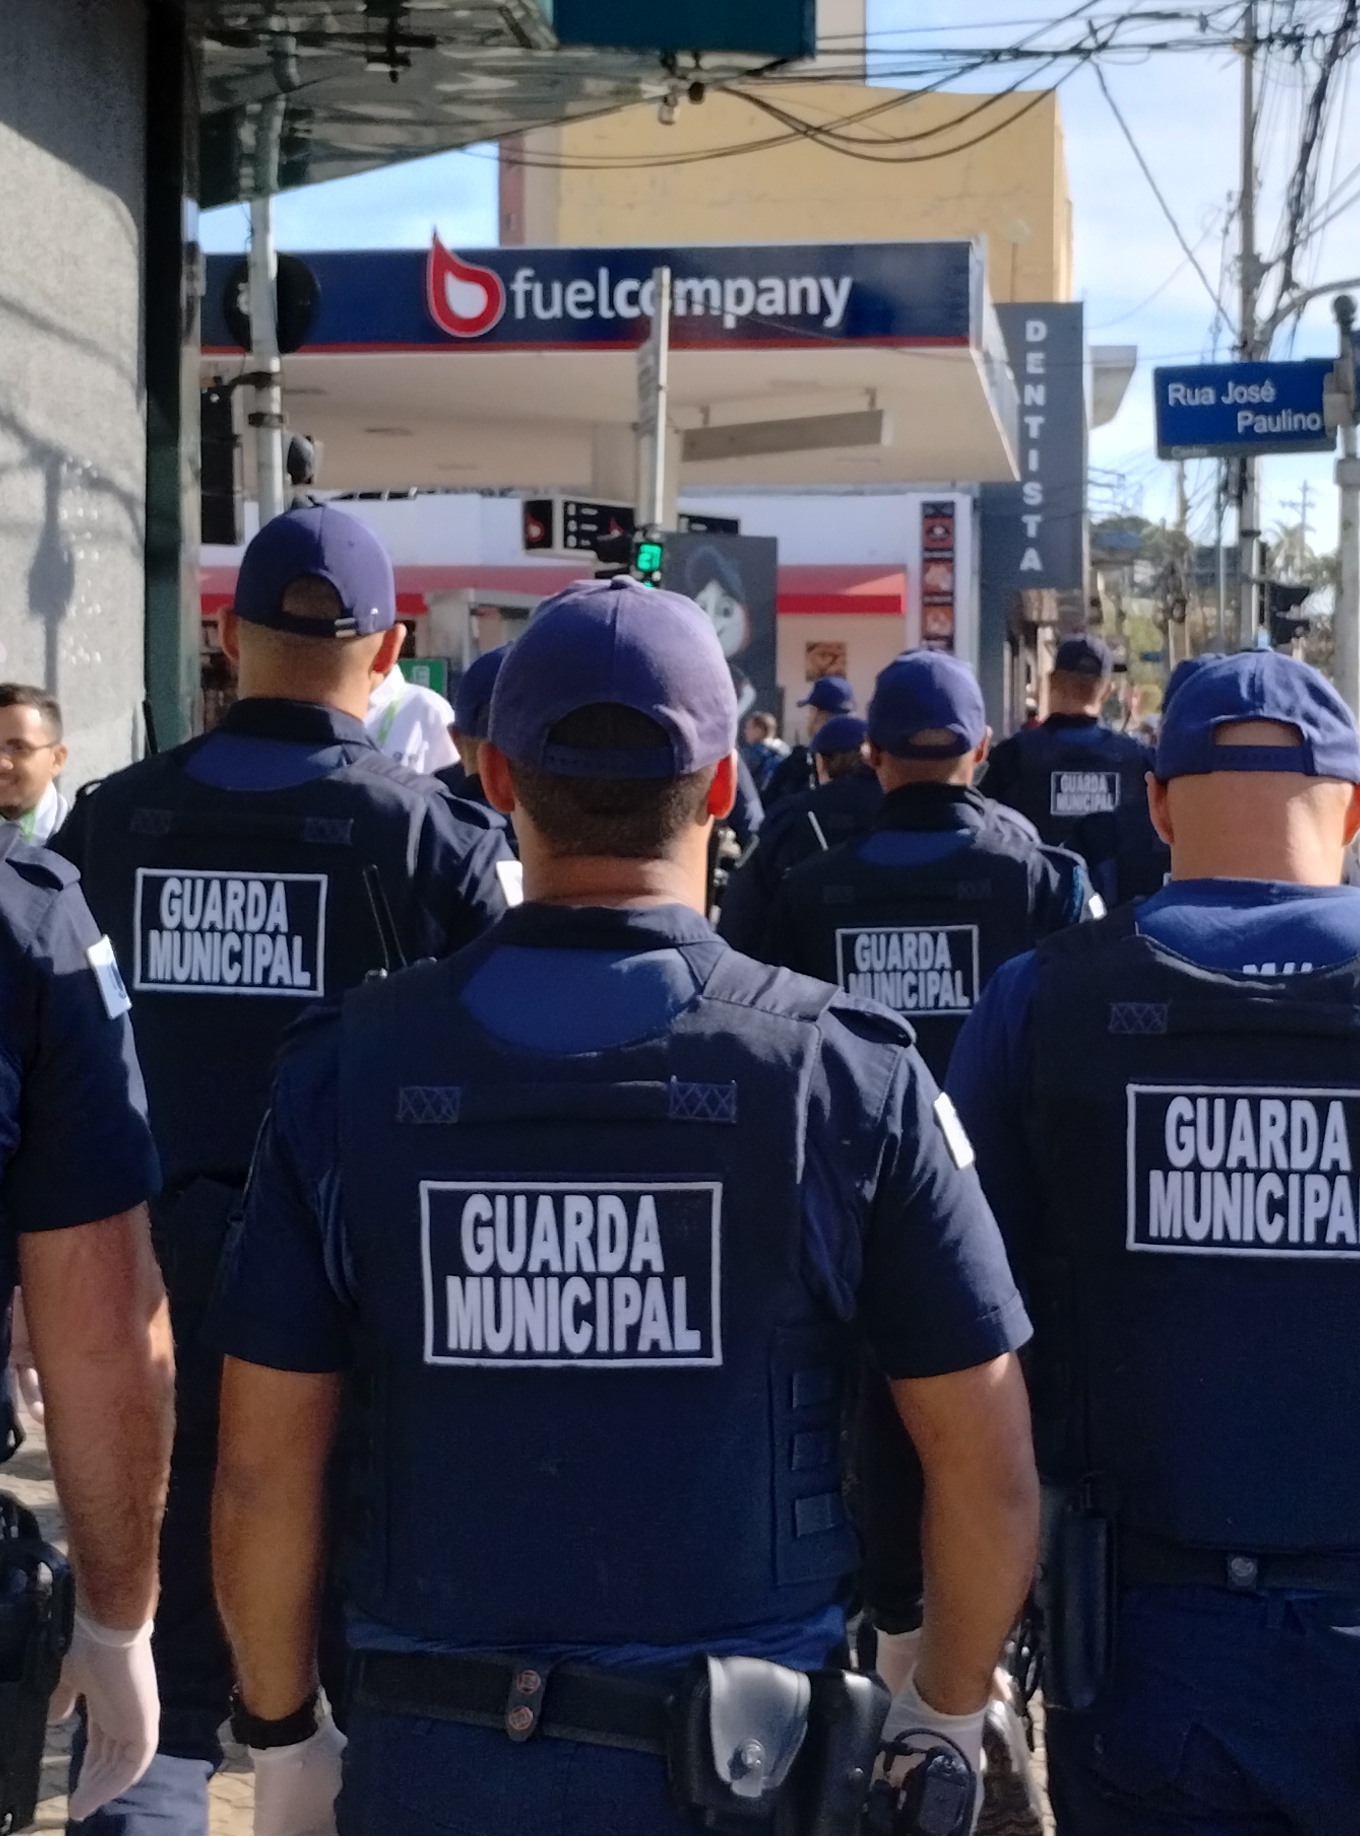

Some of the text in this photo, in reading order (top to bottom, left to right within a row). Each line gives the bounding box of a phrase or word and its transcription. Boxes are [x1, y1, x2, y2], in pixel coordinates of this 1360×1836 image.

[1168, 378, 1277, 406] Rua José
[1019, 319, 1048, 572] DENTISTA
[1236, 408, 1323, 434] Paulino
[1060, 774, 1108, 793] GUARDA
[160, 877, 288, 933] GUARDA
[148, 929, 311, 986] MUNICIPAL
[854, 931, 952, 973] GUARDA
[848, 970, 970, 1009] MUNICIPAL
[1164, 1096, 1353, 1172] GUARDA
[460, 1193, 665, 1275] GUARDA
[445, 1274, 702, 1355] MUNICIPAL
